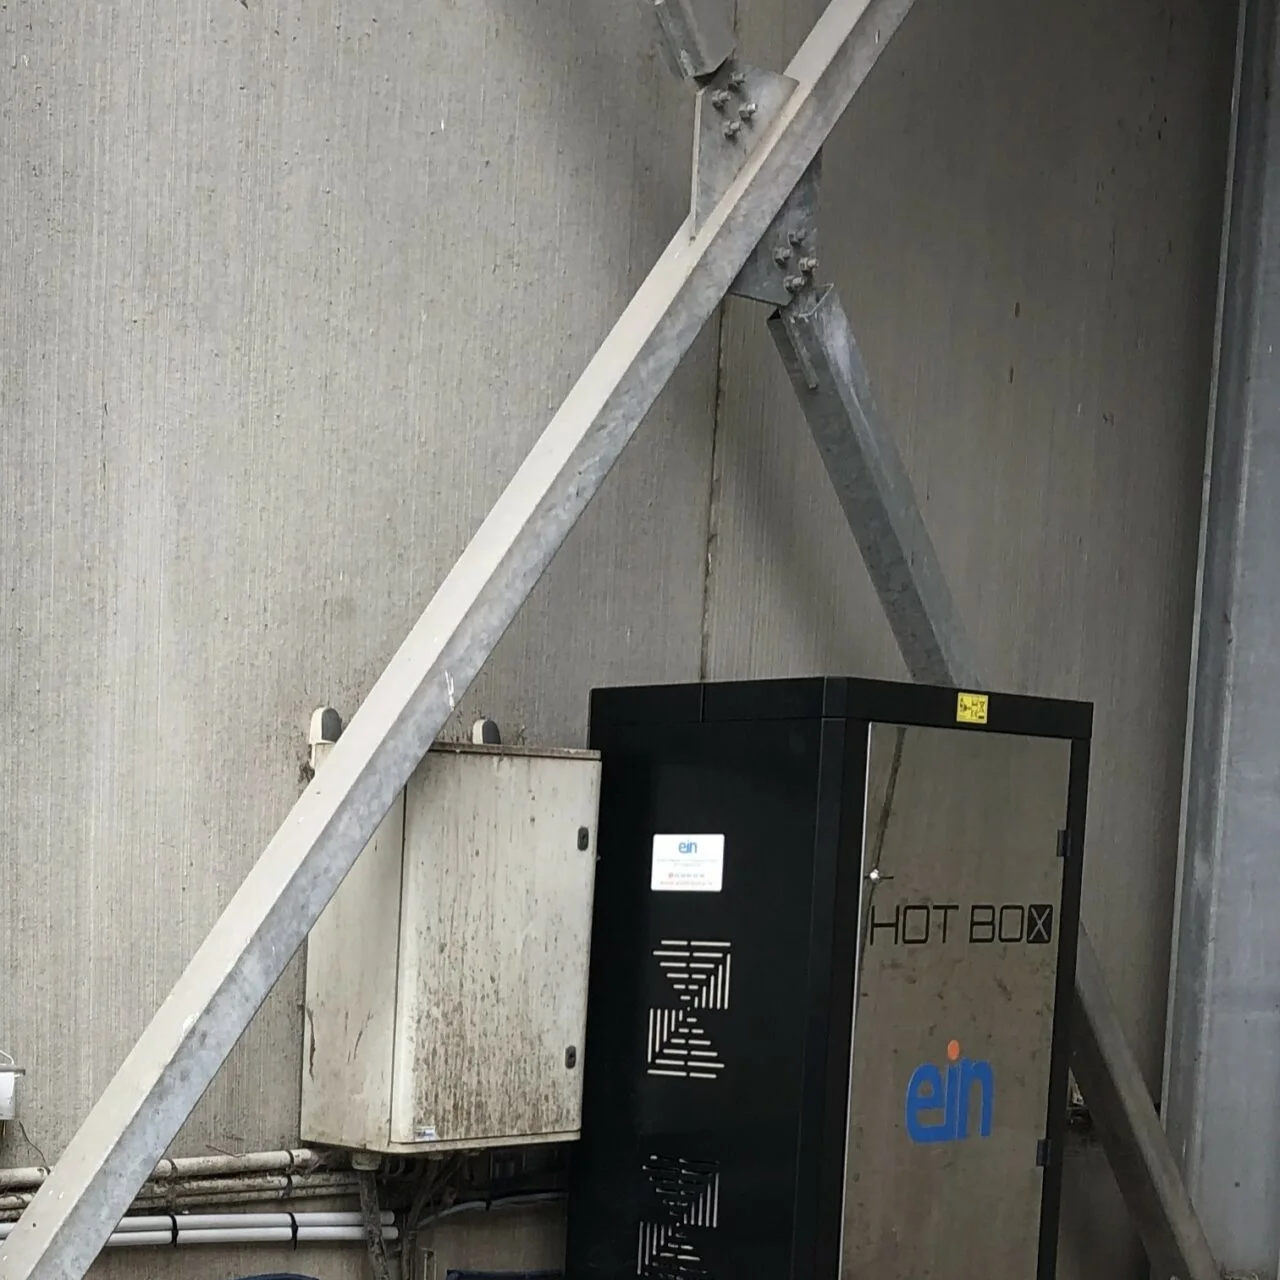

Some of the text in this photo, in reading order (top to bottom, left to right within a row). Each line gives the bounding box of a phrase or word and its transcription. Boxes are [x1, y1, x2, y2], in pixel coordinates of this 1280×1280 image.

[870, 904, 1053, 945] HOT BOX
[905, 1039, 994, 1144] ein
